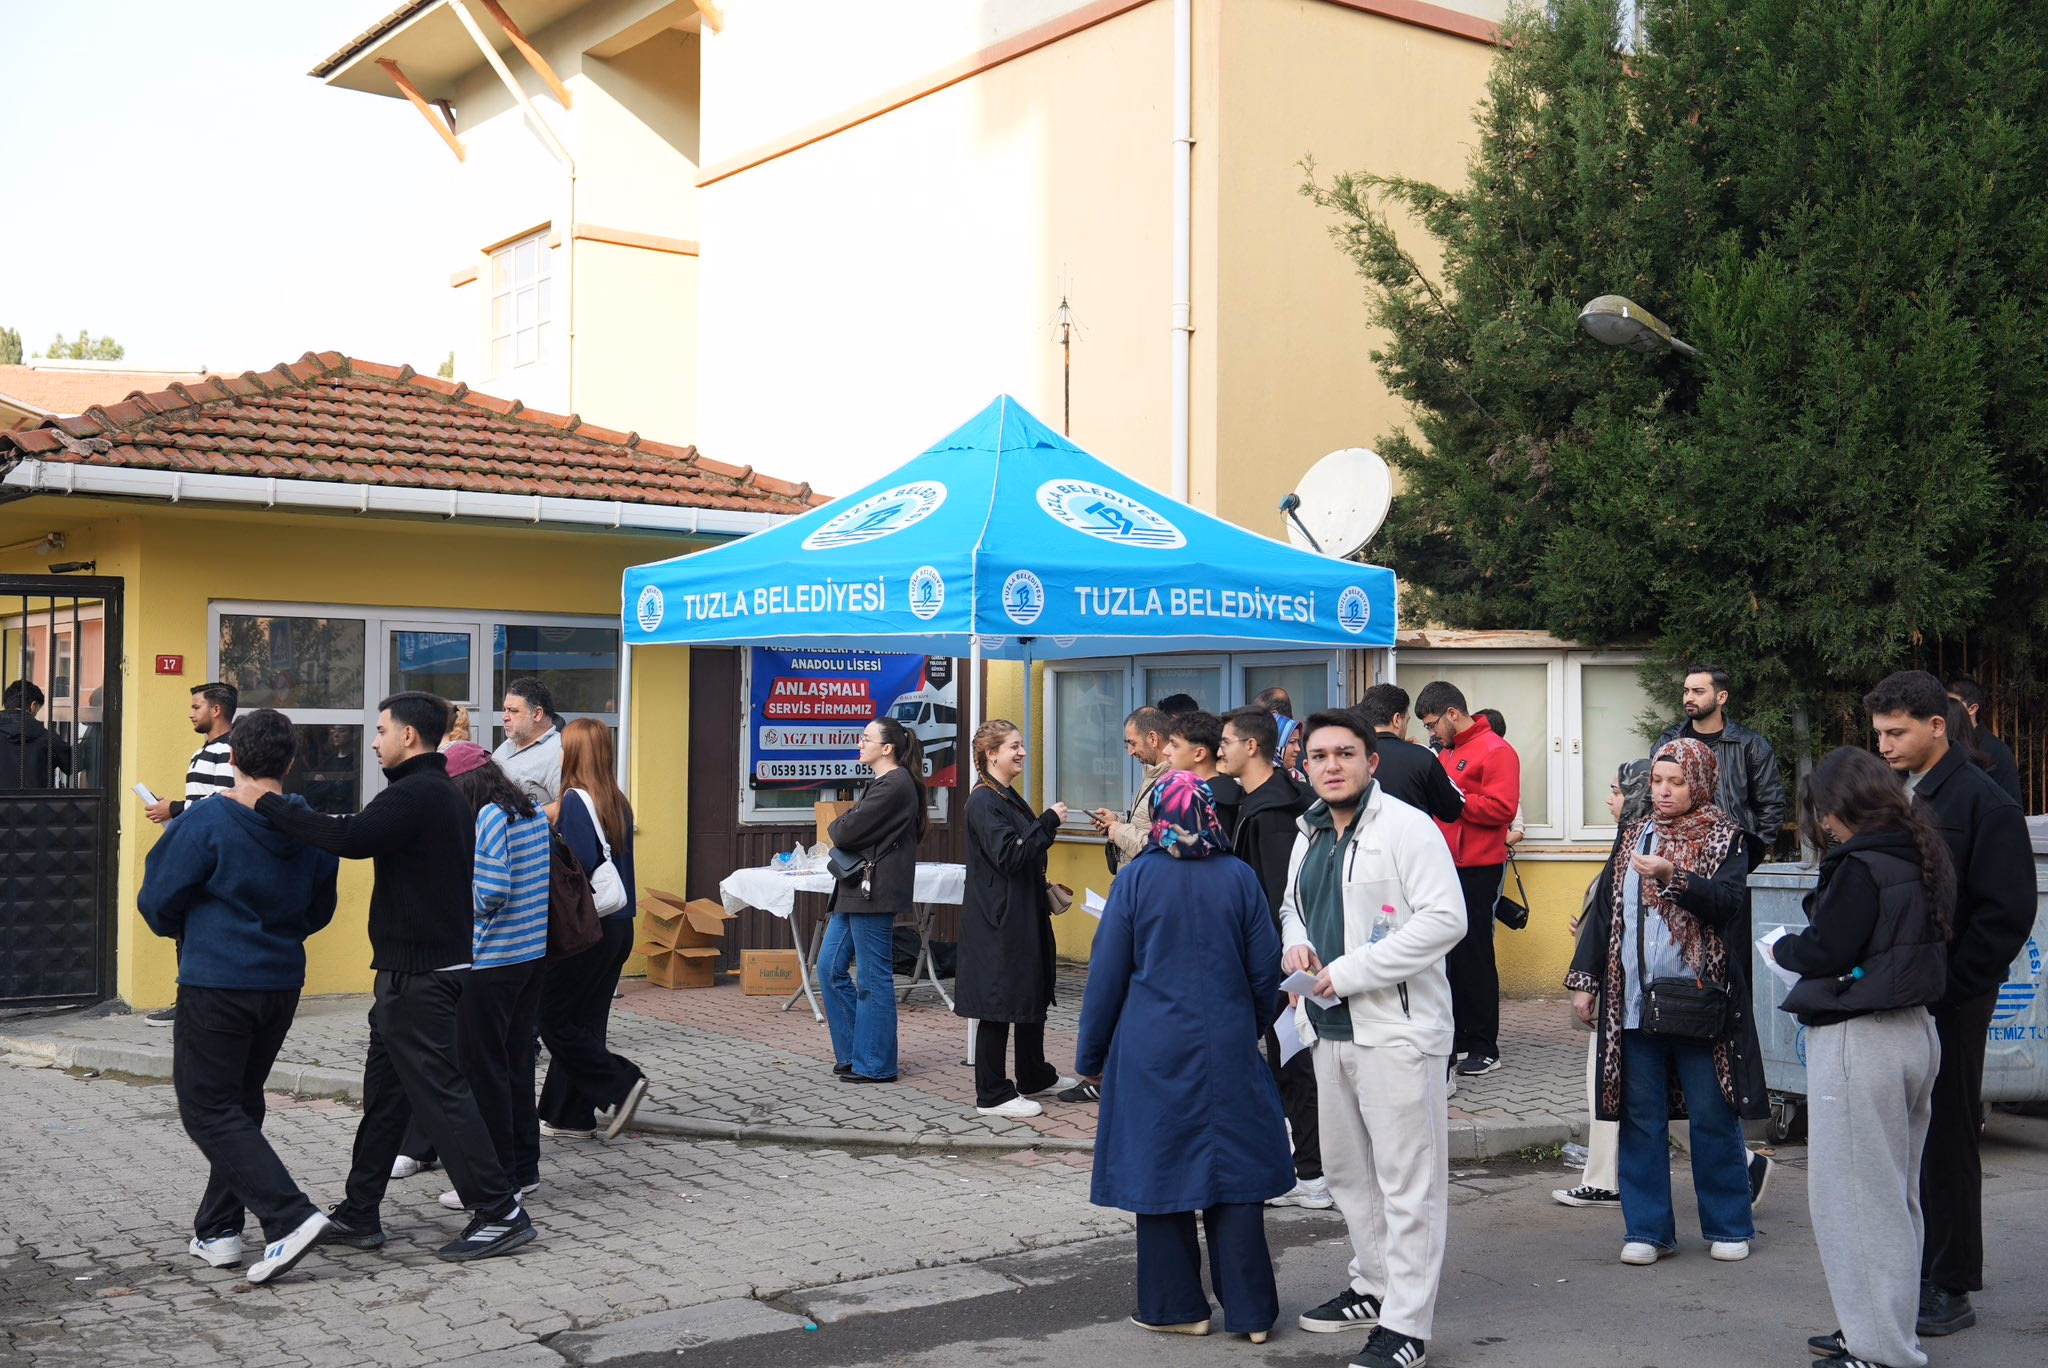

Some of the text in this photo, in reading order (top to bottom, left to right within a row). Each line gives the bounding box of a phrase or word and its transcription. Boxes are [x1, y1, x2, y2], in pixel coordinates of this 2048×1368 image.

[683, 575, 886, 620] TUZLA BELEDİYESİ
[1074, 586, 1316, 623] TUZLA BELEDİYESİ
[163, 659, 176, 670] 17
[791, 658, 881, 671] ANADOLU LİSESİ
[775, 681, 865, 699] ANLAŞMALI
[769, 701, 872, 715] SERVİS FİRMAMIZ
[783, 733, 807, 745] YGZ
[810, 730, 860, 745] TURİZM
[771, 764, 796, 776] 0539
[799, 764, 817, 776] 315
[820, 764, 832, 776] 75
[835, 764, 847, 775] 82
[855, 764, 876, 775] 055
